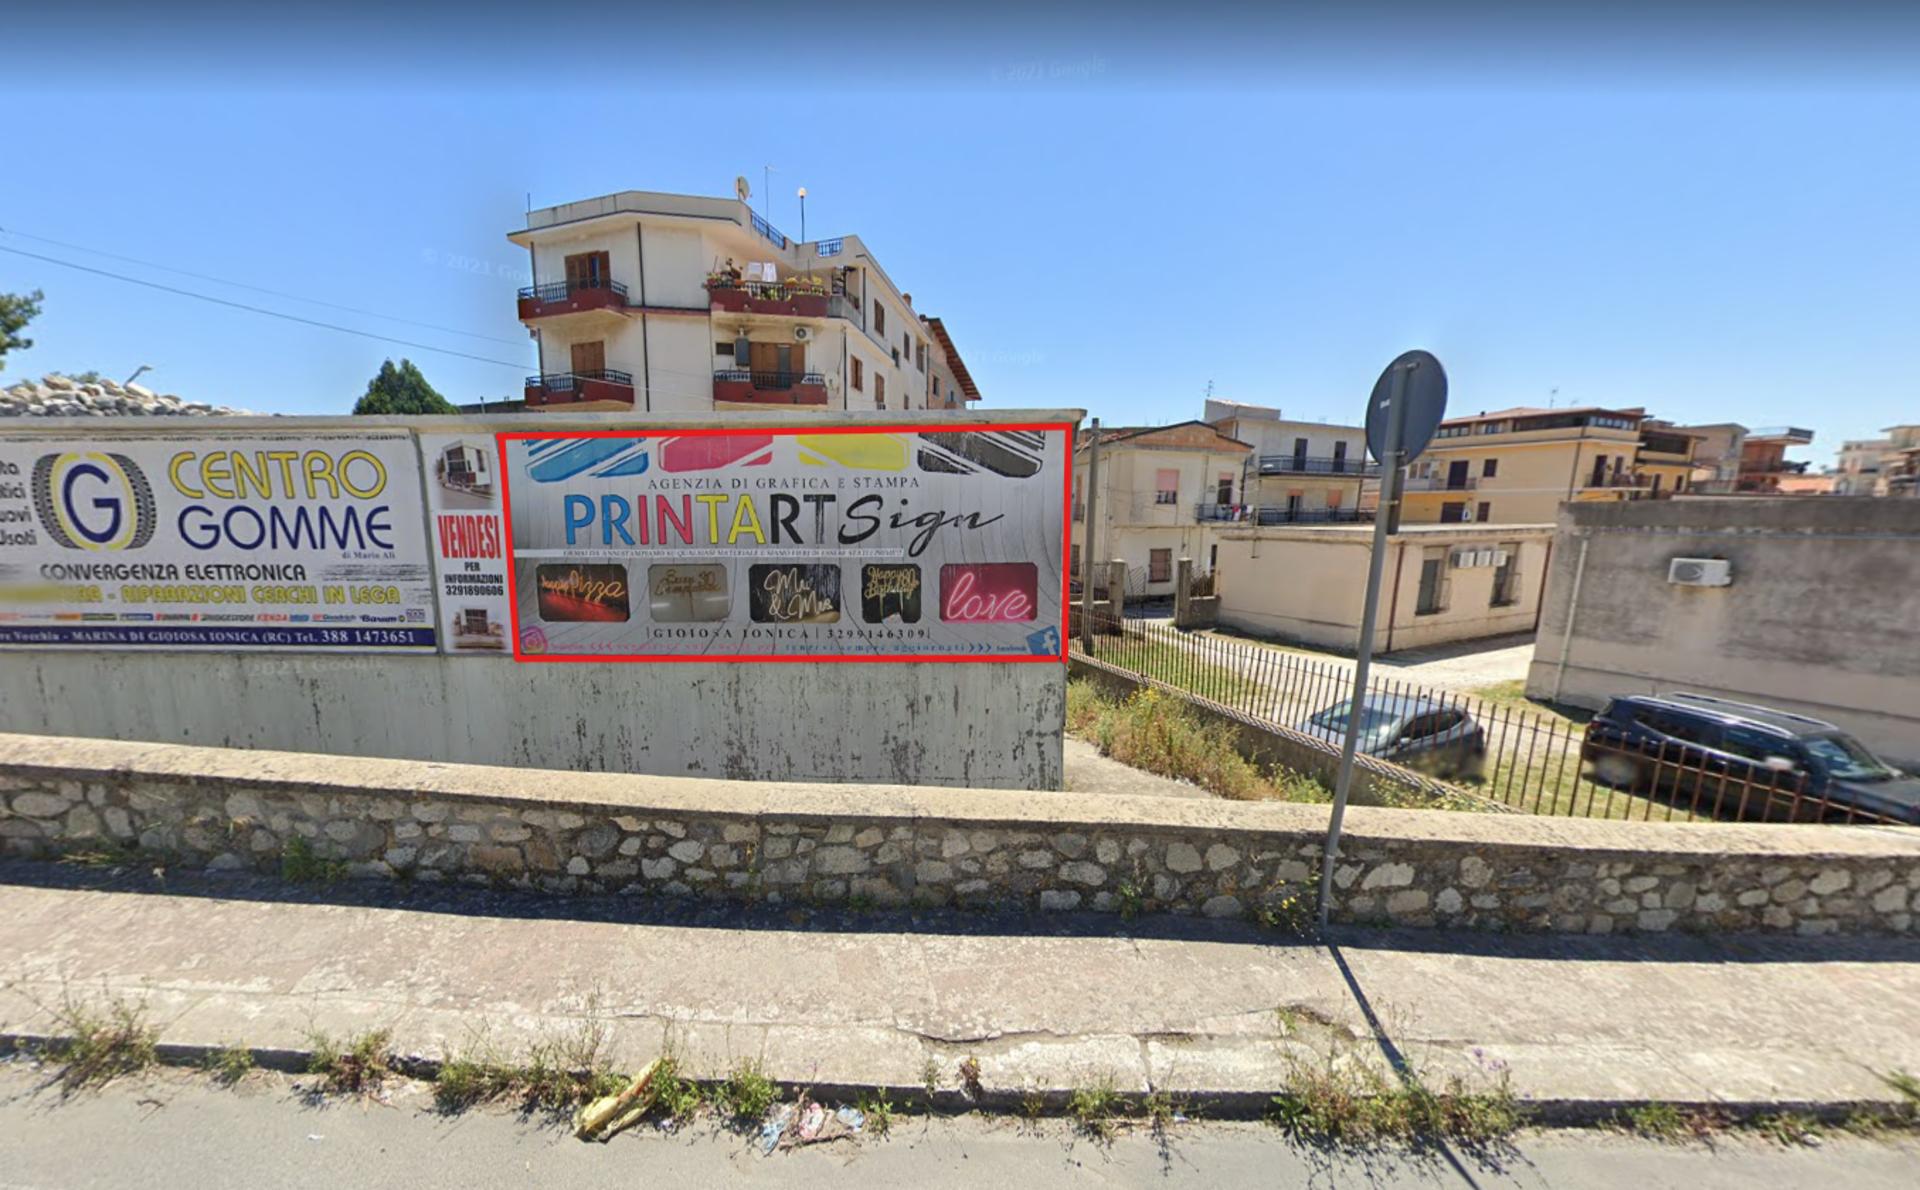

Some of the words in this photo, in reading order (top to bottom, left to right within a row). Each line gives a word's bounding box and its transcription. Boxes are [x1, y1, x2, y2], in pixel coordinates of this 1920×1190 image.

[168, 449, 388, 500] CENTRO
[648, 478, 722, 490] AGENZIA
[731, 478, 748, 489] DI
[756, 477, 830, 489] GRAFICA
[838, 477, 846, 488] E
[853, 476, 920, 488] STAMPA
[63, 463, 122, 544] G
[178, 505, 394, 550] GOMME
[438, 514, 502, 559] VENDESI
[353, 550, 381, 560] Mario
[40, 564, 181, 581] CONVERGENZA
[184, 564, 306, 581] ELETTRONICA
[464, 561, 481, 572] PER
[444, 574, 504, 584] INFORMAZIONI
[121, 585, 246, 604] RIPARAZIONI
[252, 585, 318, 604] CERCHI
[323, 585, 345, 604] IN
[351, 586, 400, 604] LEGA
[445, 585, 504, 596] 3291890606
[947, 572, 1032, 620] love
[71, 631, 126, 642] MARINA
[130, 631, 145, 642] DI
[148, 631, 206, 642] GIOIOSA
[209, 631, 259, 643] IONICA
[262, 631, 292, 644] (RC)
[295, 632, 318, 643] Tel.
[322, 630, 349, 643] 388
[354, 630, 415, 643] 1473651
[742, 628, 809, 640] IONICA
